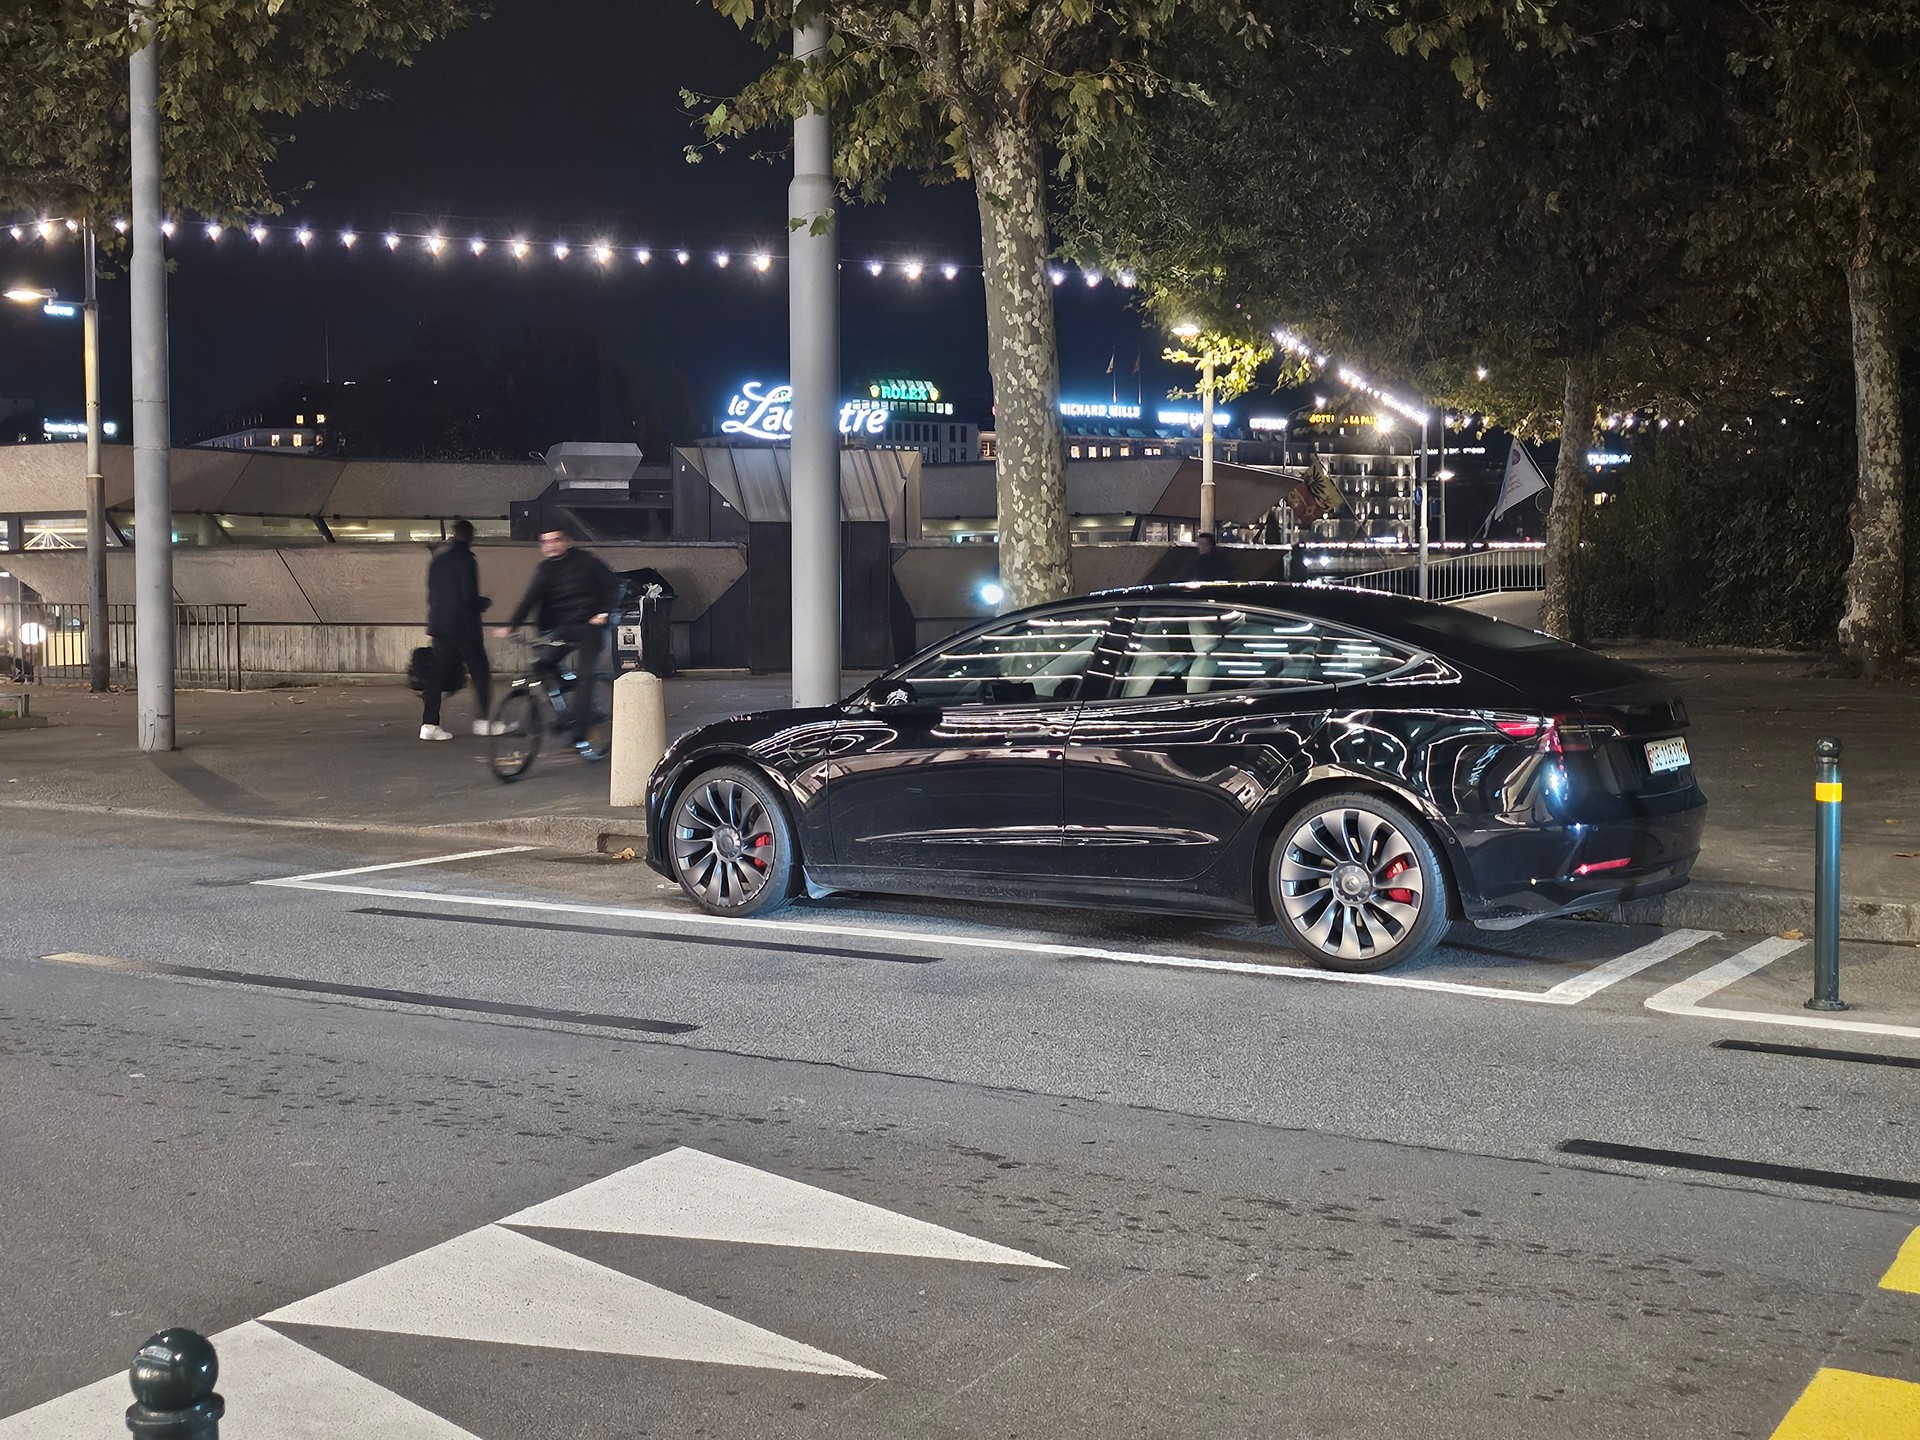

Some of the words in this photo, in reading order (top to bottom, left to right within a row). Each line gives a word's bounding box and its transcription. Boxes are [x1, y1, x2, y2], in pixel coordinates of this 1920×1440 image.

[881, 384, 928, 400] ROLEX
[727, 394, 750, 416] le
[1060, 403, 1107, 416] RICHARD
